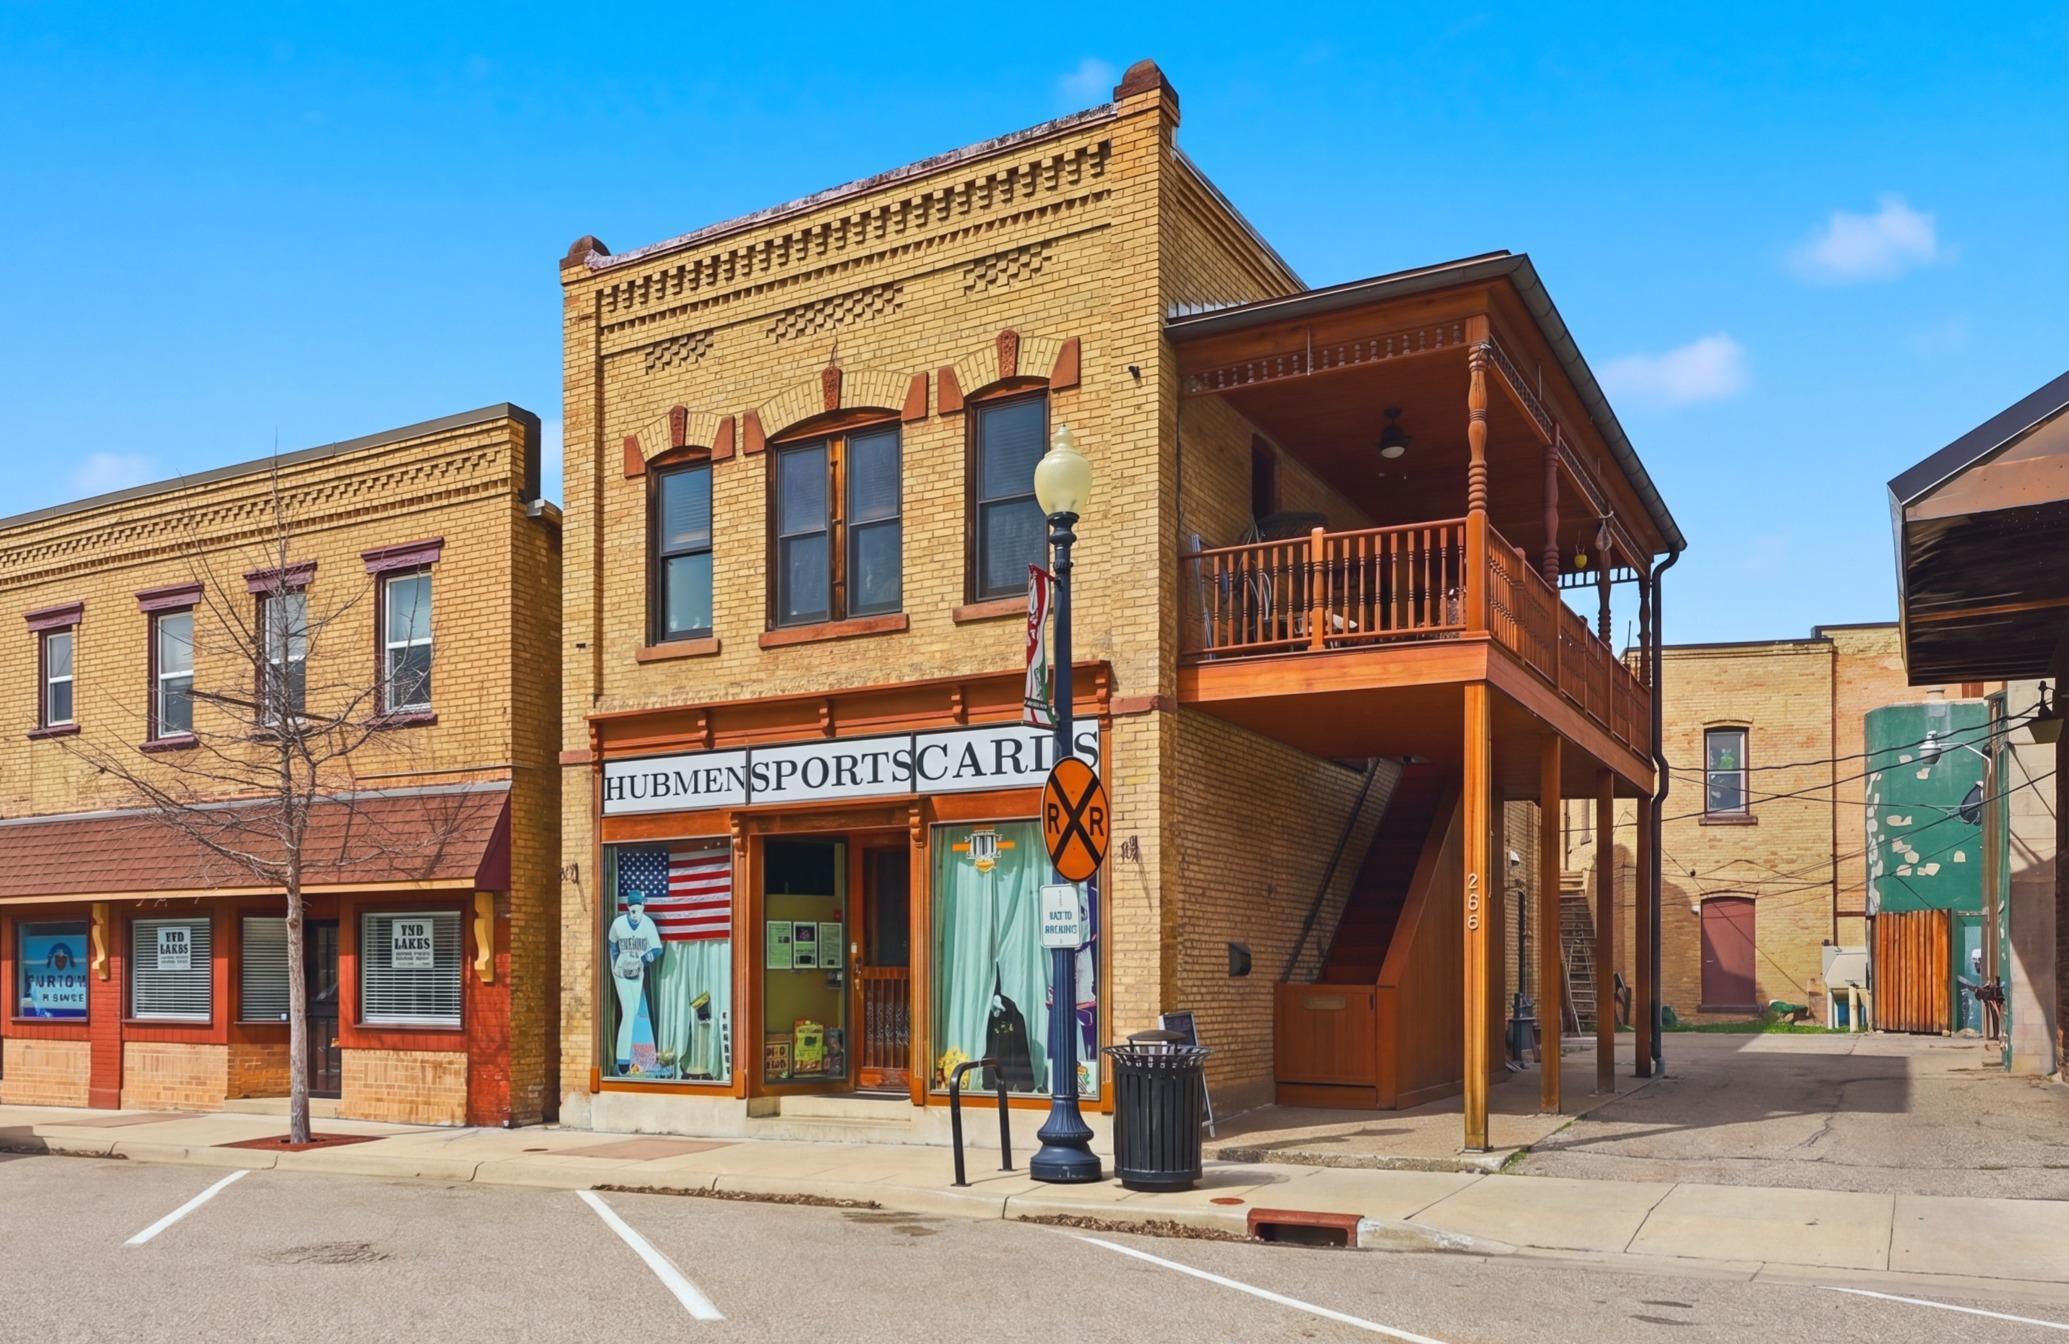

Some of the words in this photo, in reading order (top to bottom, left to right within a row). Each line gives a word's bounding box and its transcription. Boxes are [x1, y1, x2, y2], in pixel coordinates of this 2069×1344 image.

[604, 765, 747, 801] HUBMEN
[750, 749, 913, 793] SPORTS
[1047, 803, 1060, 834] R
[1089, 807, 1104, 836] R
[1468, 873, 1479, 930] 266
[394, 937, 430, 950] LAKES
